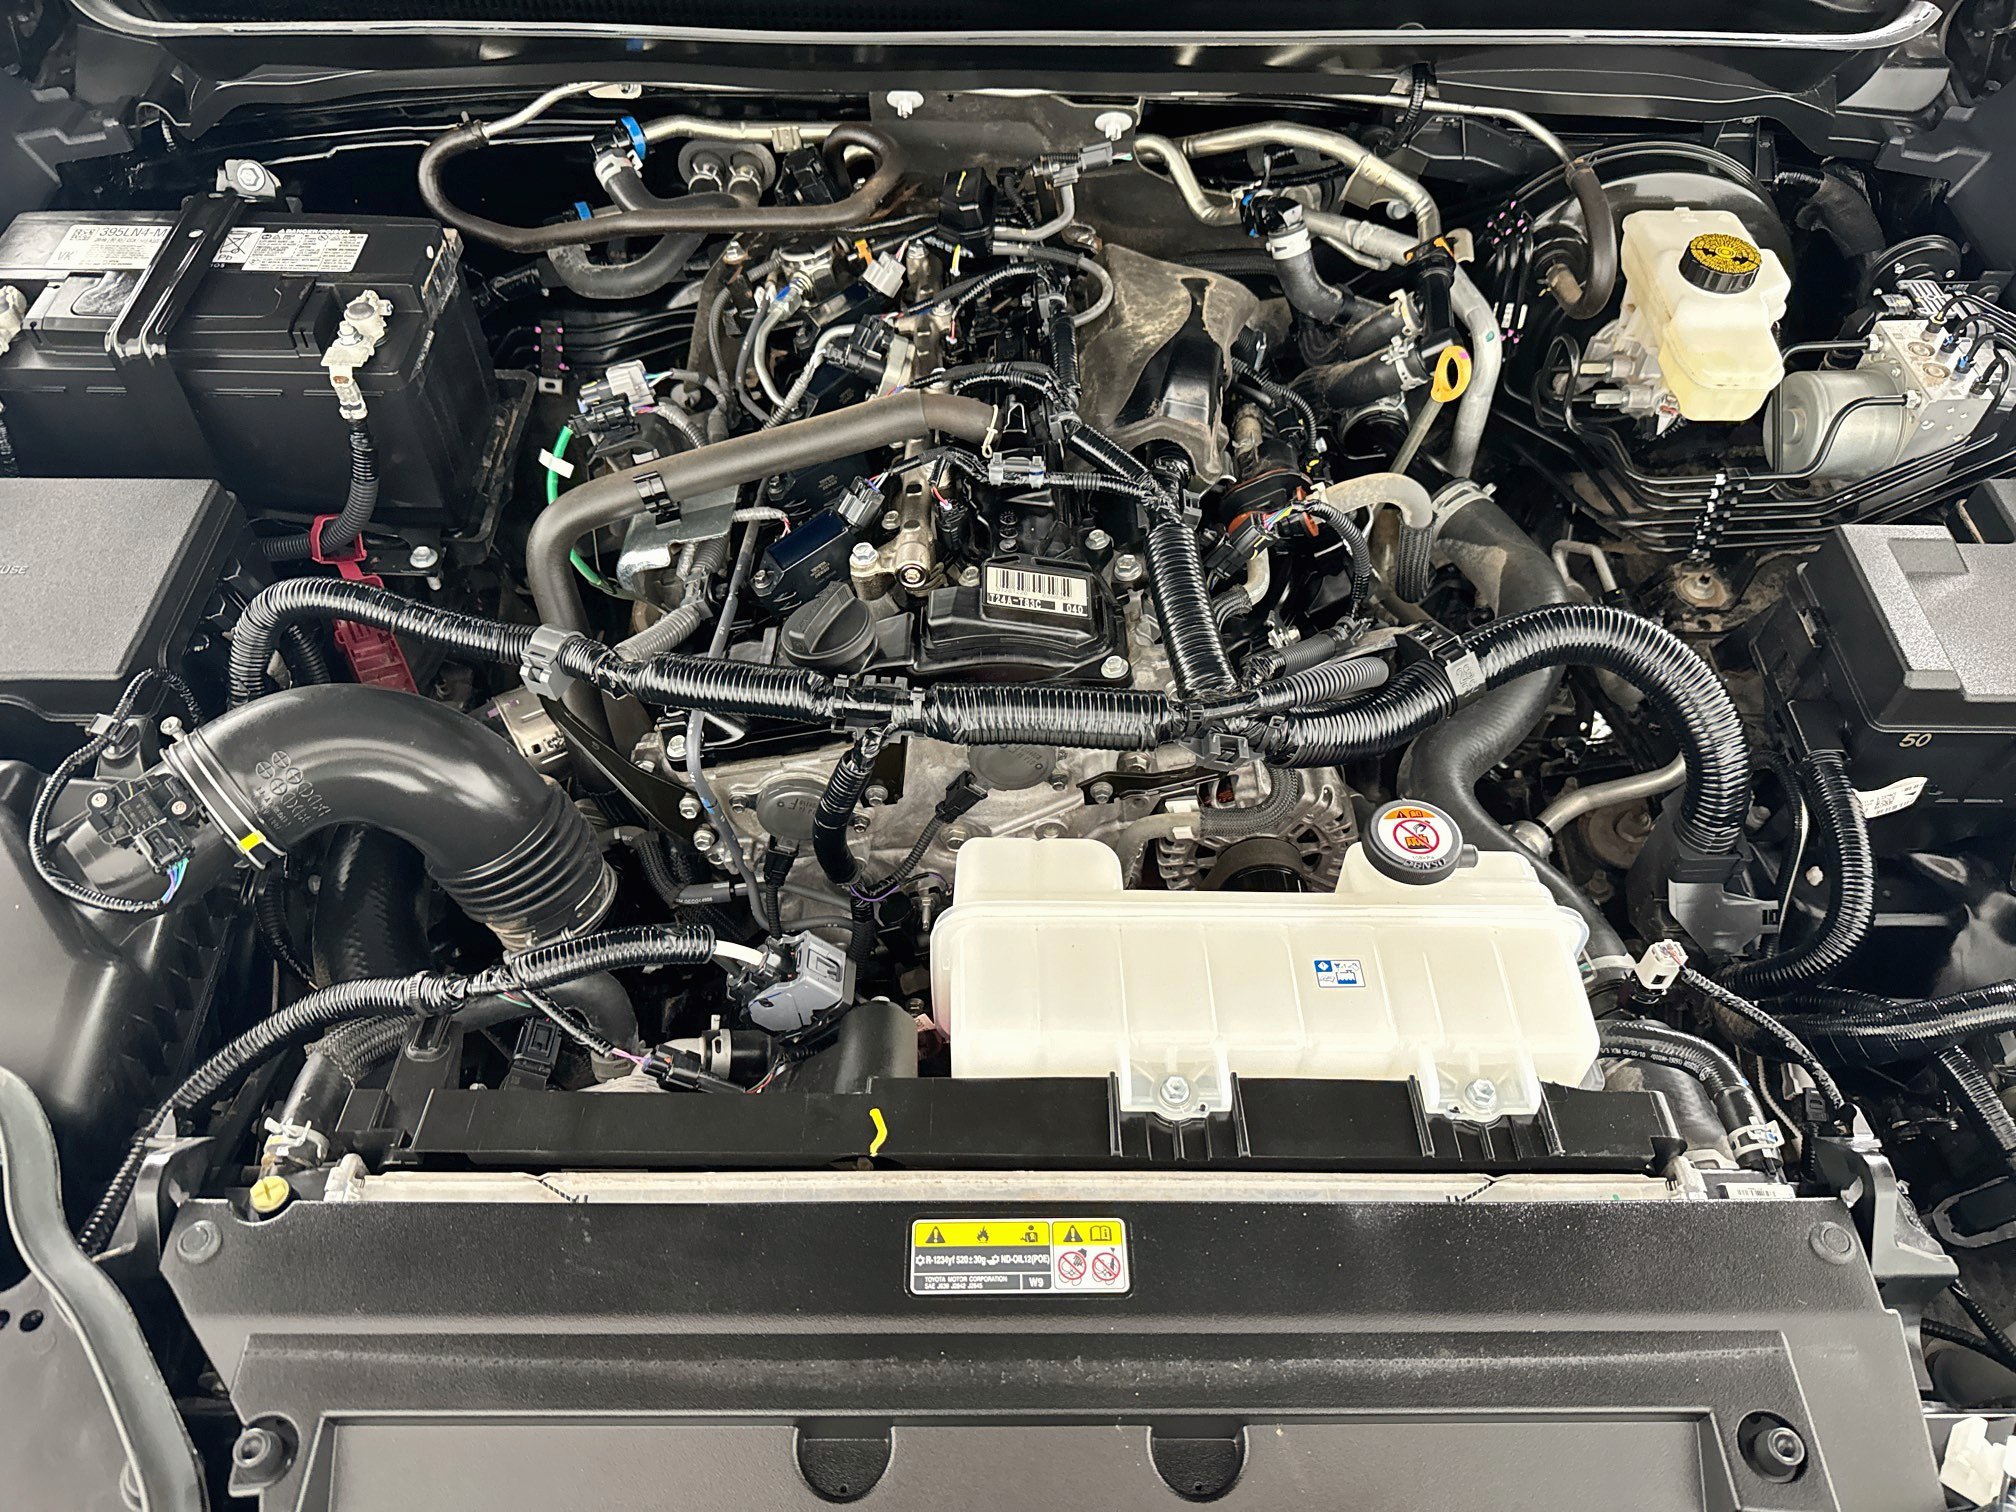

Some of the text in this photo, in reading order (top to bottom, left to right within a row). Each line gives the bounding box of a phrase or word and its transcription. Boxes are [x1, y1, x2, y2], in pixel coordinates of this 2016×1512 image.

[0, 565, 29, 574] USE
[1898, 733, 1933, 748] 50
[1403, 858, 1447, 870] DENSO
[925, 1254, 956, 1267] R-1234yf
[968, 1275, 1008, 1283] CORPORATION
[1028, 1276, 1045, 1288] W9
[924, 1282, 936, 1290] SAE
